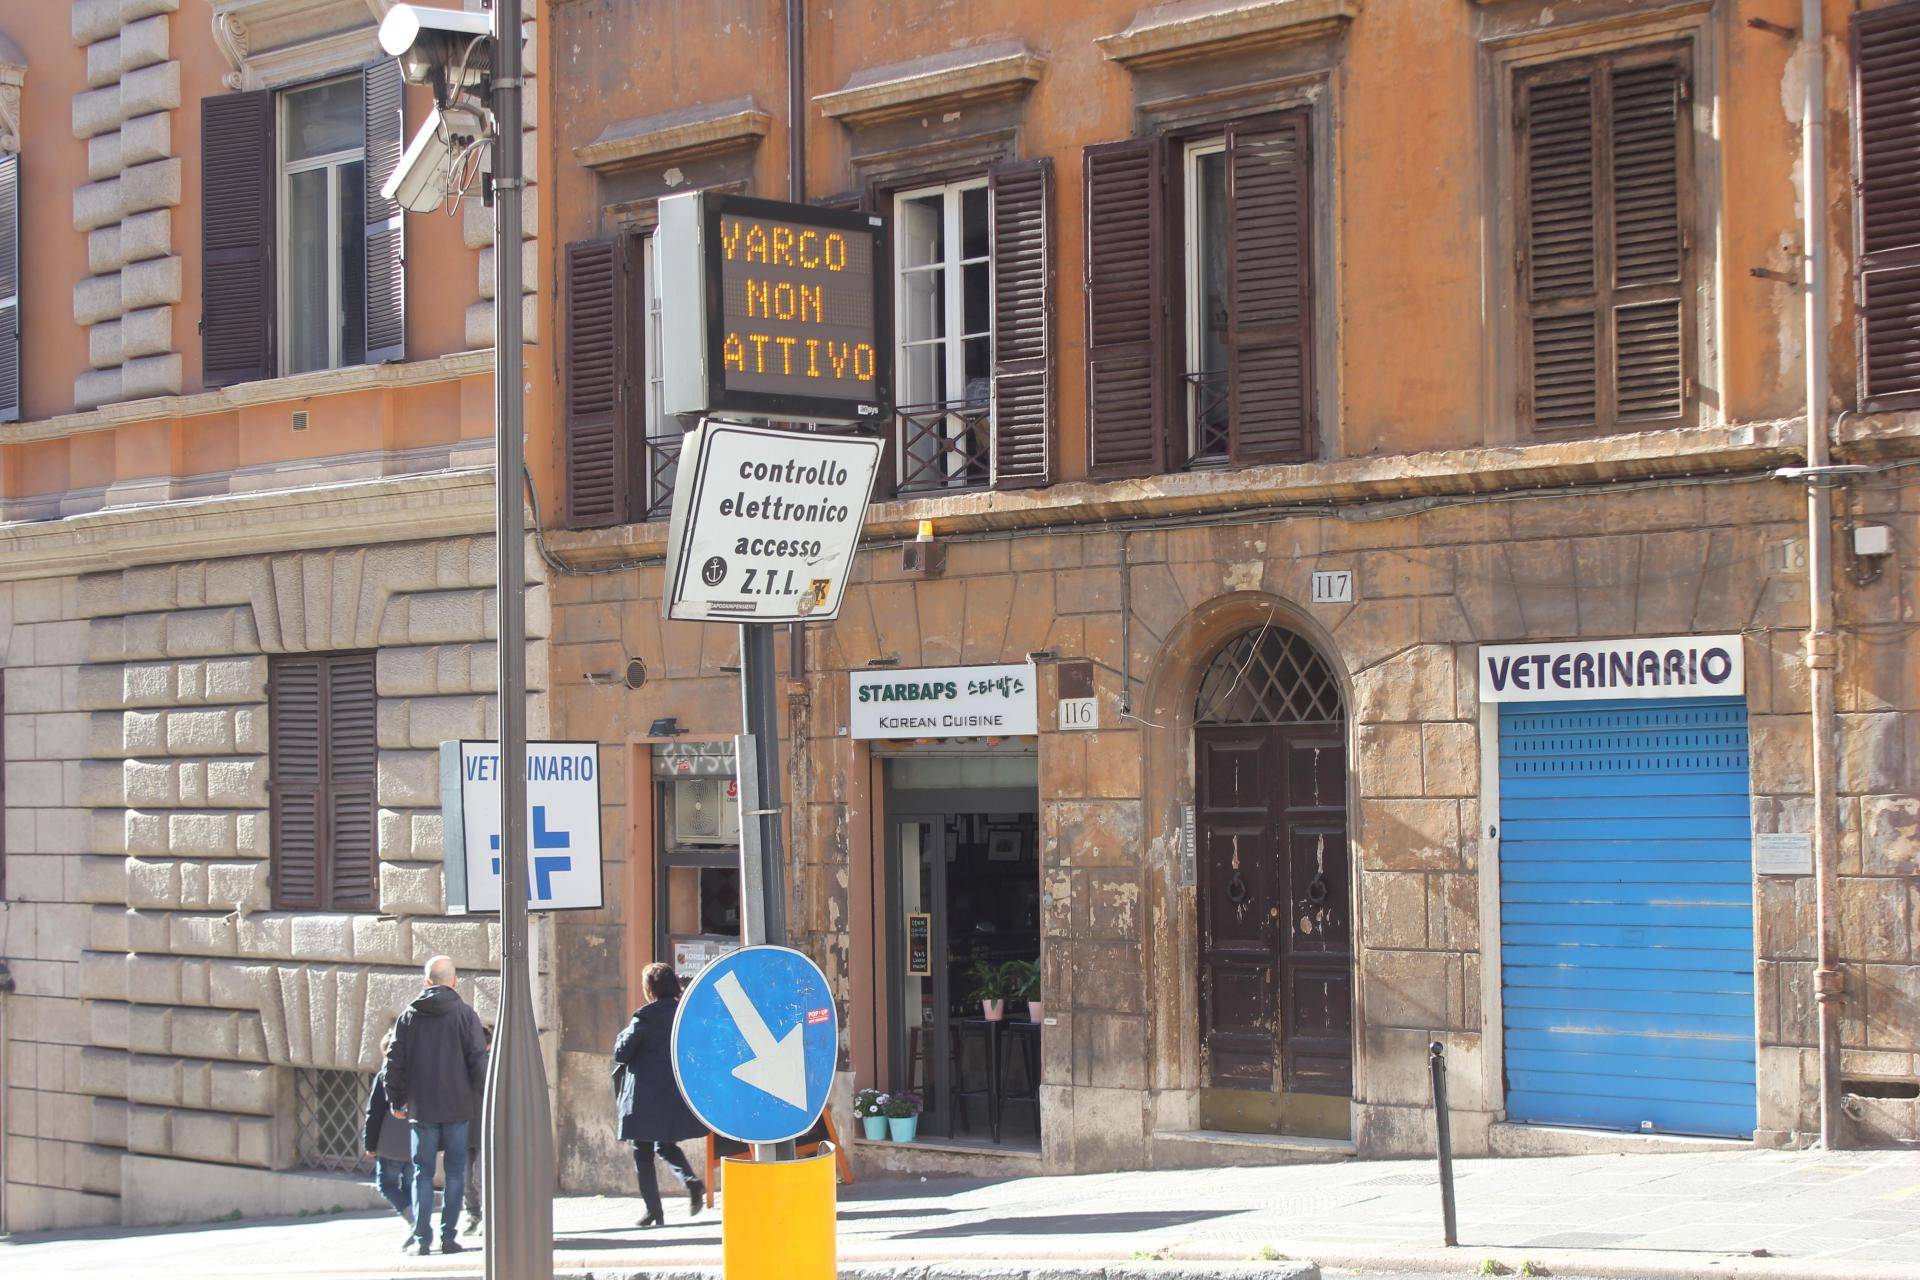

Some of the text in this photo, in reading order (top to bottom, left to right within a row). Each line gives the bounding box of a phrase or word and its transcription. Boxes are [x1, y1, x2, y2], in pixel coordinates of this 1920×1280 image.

[720, 219, 847, 271] VARCO
[747, 279, 823, 324] NON
[723, 332, 875, 381] ATTIVO
[739, 458, 848, 486] controllo
[719, 491, 848, 523] elettronico
[734, 537, 822, 558] accesso
[740, 568, 799, 595] Z.T.L.
[1317, 574, 1348, 598] 117
[1487, 647, 1733, 692] VETERINARIO
[858, 681, 958, 703] STARBAPS
[879, 714, 1003, 729] KOREAN CUISINE
[1065, 702, 1093, 724] 116
[466, 755, 593, 782] VETINARIO
